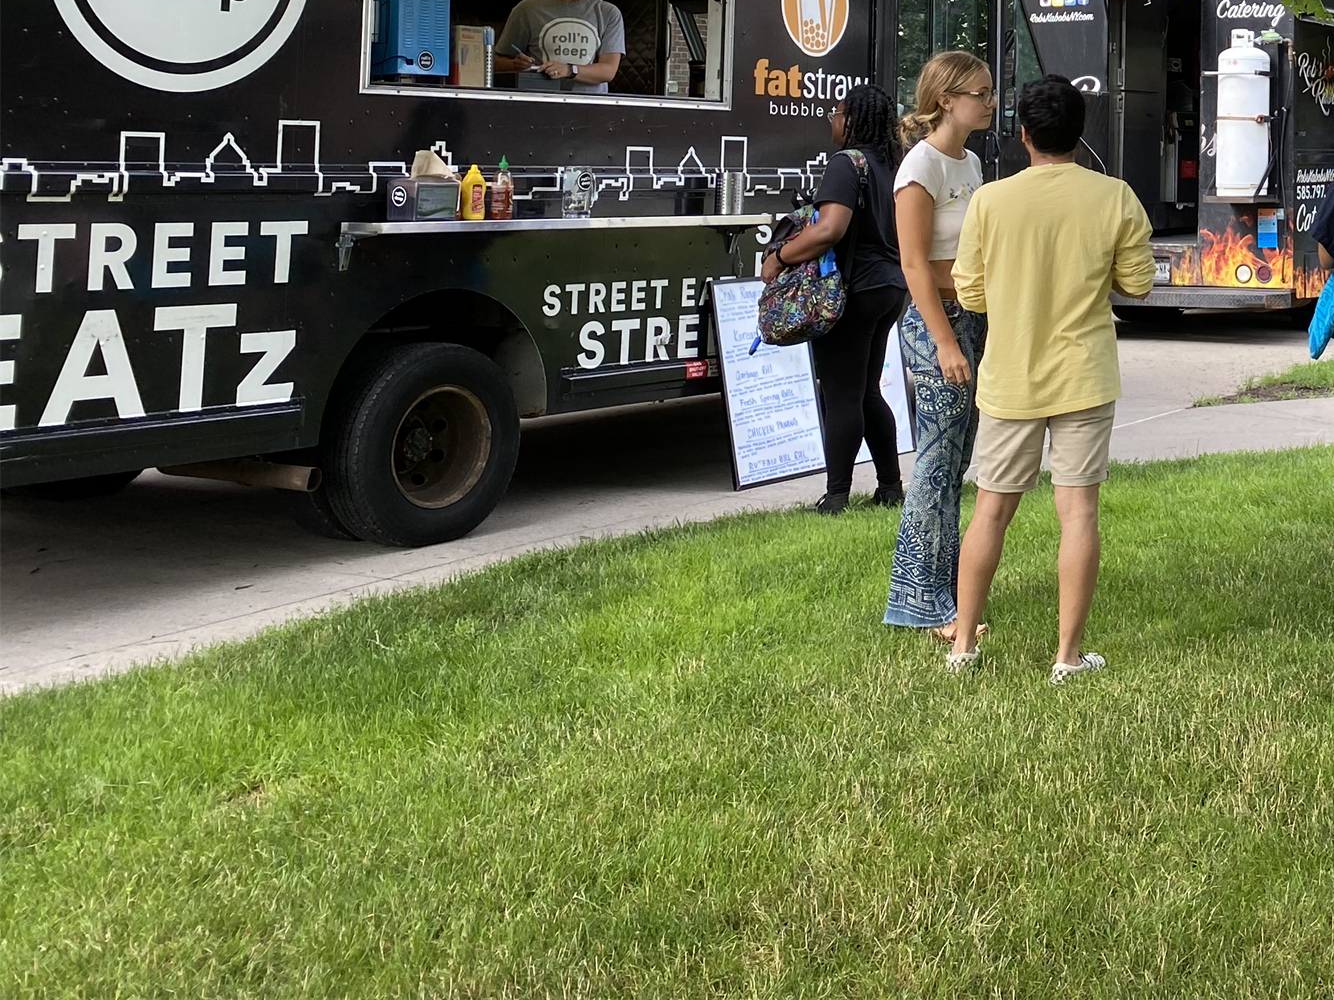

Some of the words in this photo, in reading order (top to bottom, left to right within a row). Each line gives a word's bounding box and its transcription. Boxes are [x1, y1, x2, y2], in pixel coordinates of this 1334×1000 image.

[1217, 0, 1285, 27] Catering
[552, 32, 588, 43] roll'n
[554, 45, 587, 59] deep
[769, 101, 824, 117] bubble
[0, 221, 309, 293] TREET
[542, 279, 669, 317] STREET
[681, 276, 737, 308] EA
[740, 397, 757, 407] Fresh
[760, 393, 780, 405] Spring
[747, 424, 775, 439] CHICKEN
